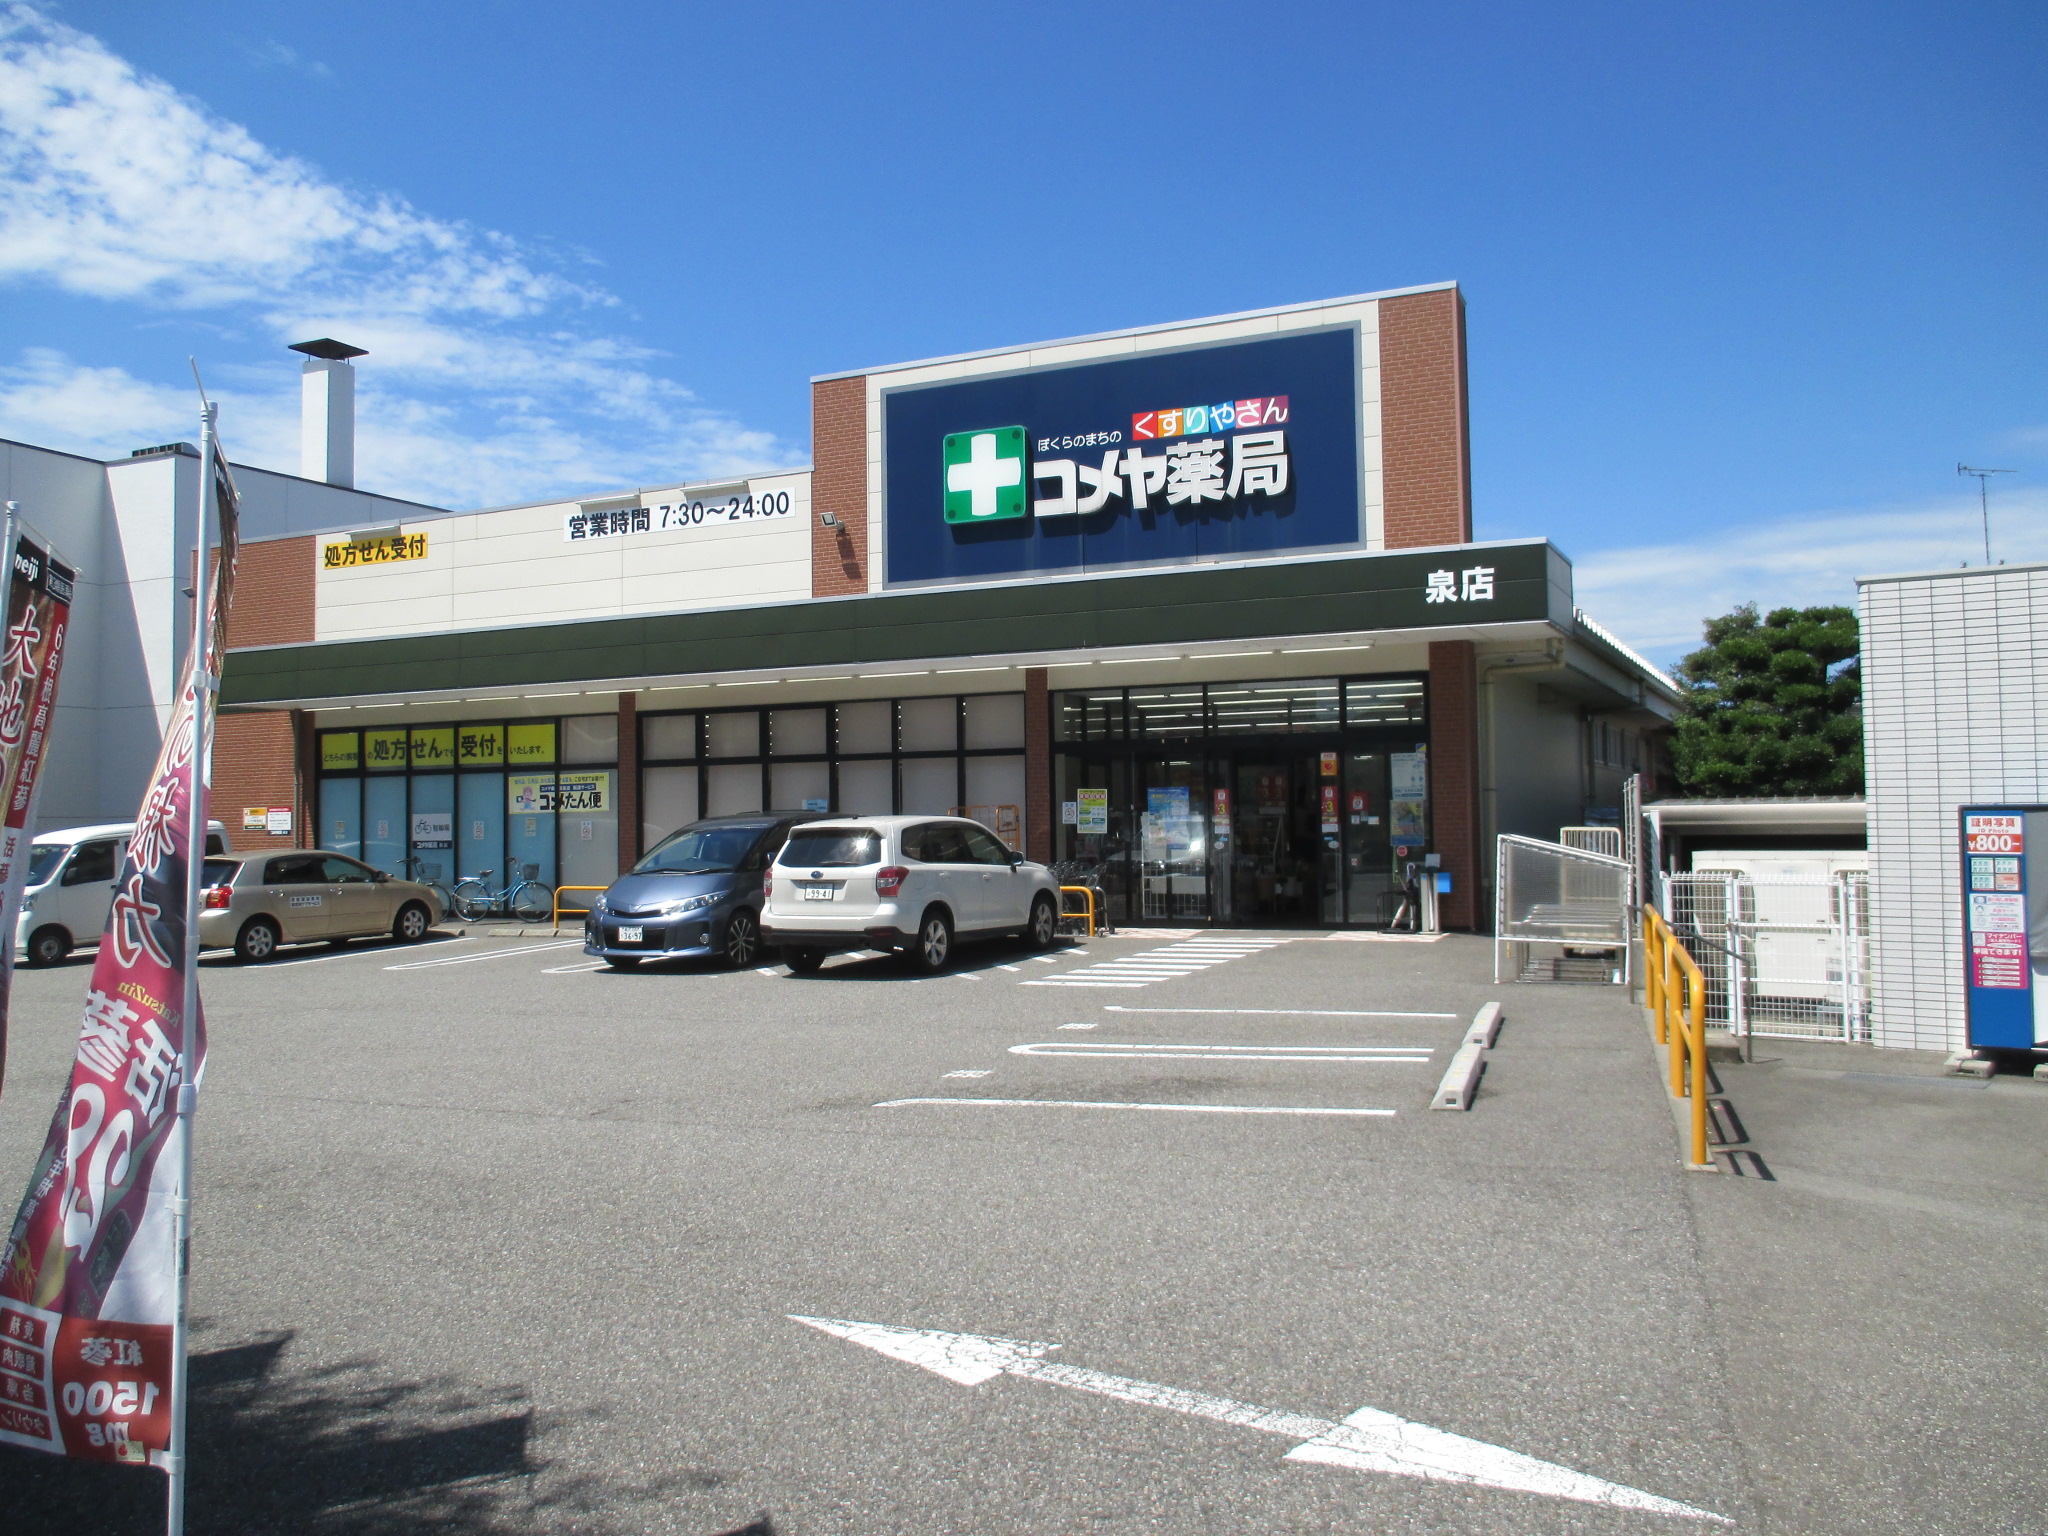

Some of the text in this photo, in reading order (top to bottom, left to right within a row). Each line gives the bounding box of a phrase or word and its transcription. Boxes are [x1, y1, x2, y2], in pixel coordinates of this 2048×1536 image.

[1037, 397, 1288, 452] ぼくらのまちの くすりやさん
[1034, 430, 1288, 517] コメヤ薬局
[569, 507, 650, 540] 営業時間
[325, 534, 425, 567] 処方せん受付
[1425, 566, 1495, 604] 泉店
[0, 604, 41, 790] 大地
[1970, 817, 2015, 828] 証明写真
[811, 889, 831, 898] 99-41
[623, 932, 642, 941] 36-97
